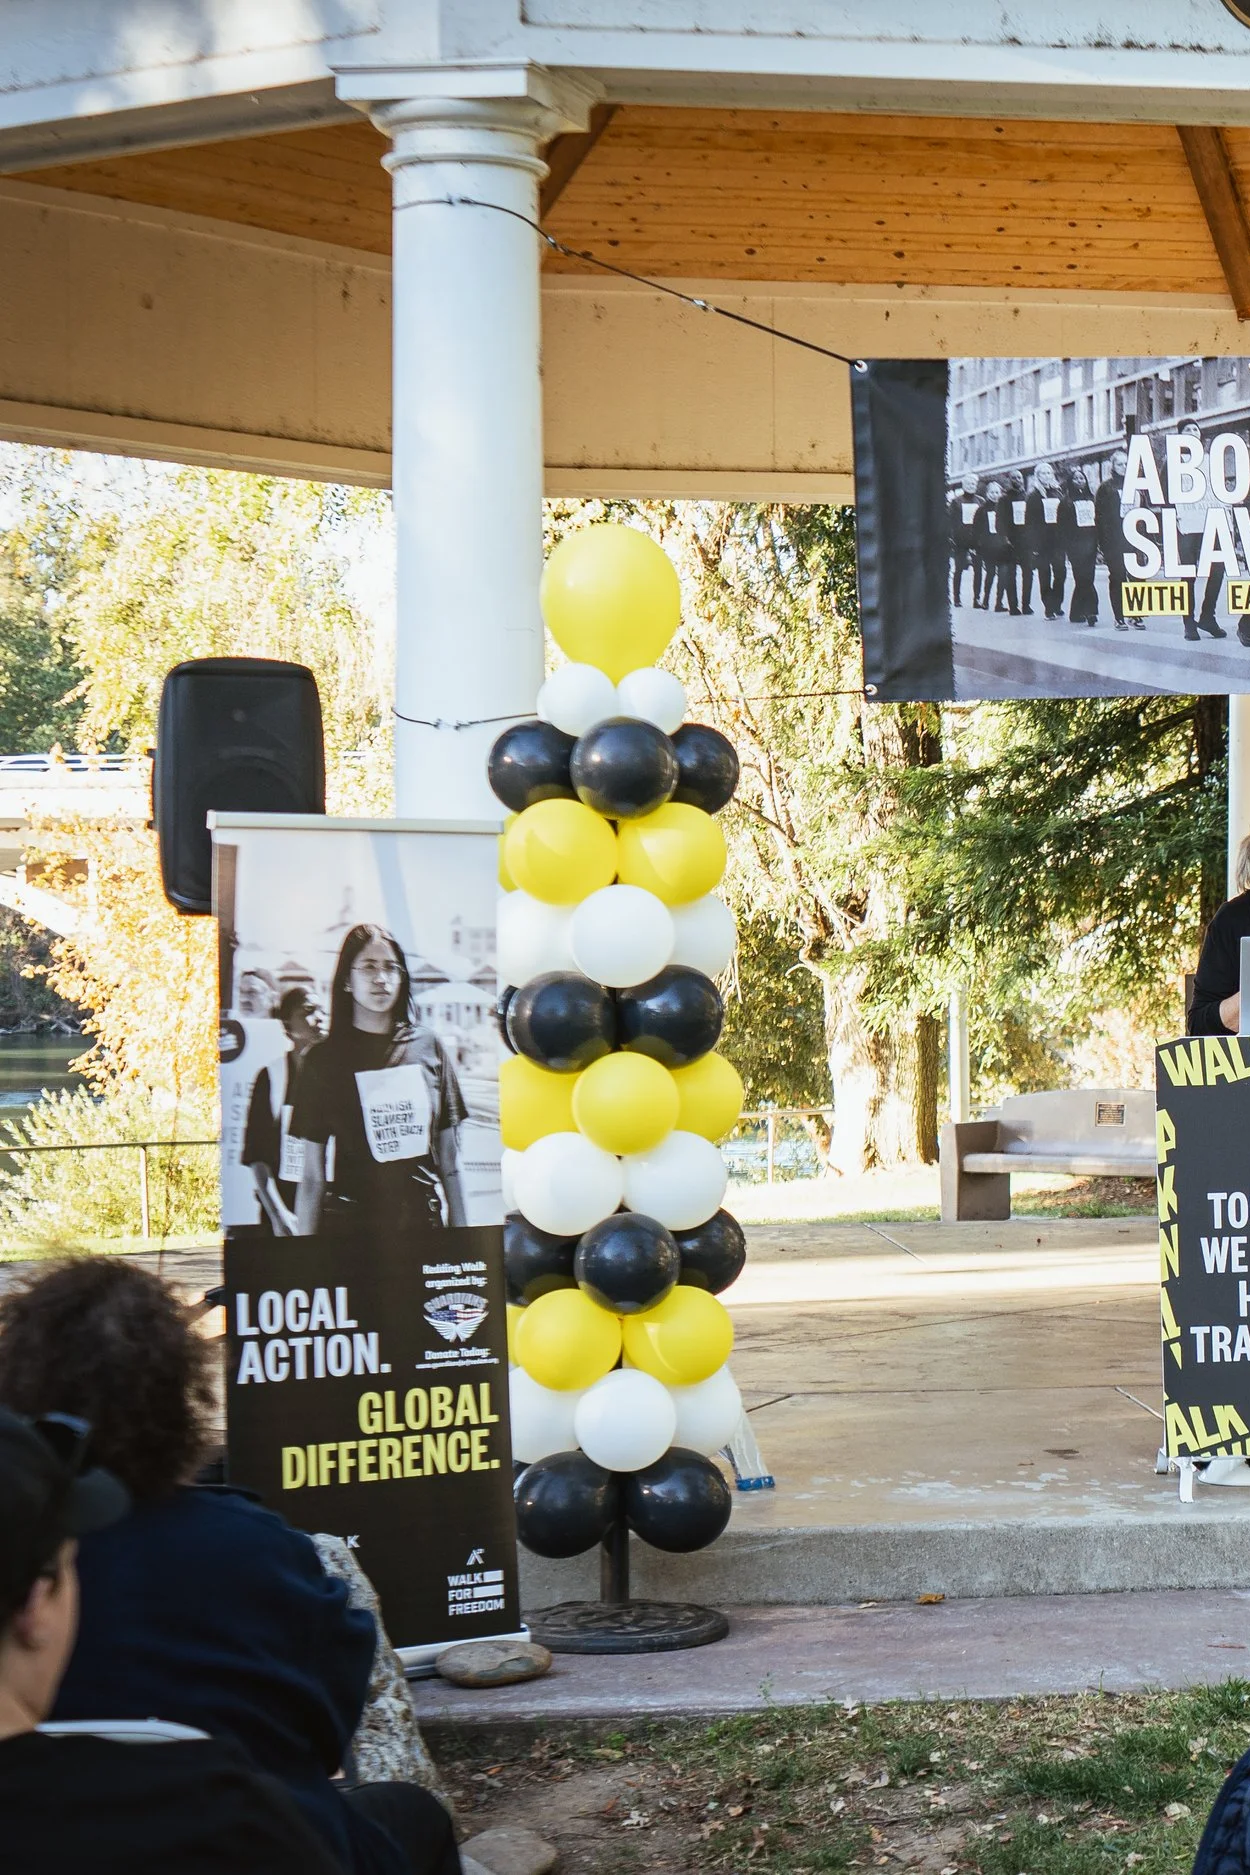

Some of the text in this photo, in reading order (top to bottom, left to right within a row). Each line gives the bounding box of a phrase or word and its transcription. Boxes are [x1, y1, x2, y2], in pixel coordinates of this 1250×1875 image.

[1125, 586, 1186, 612] WITH
[373, 1127, 398, 1141] WITH
[376, 1140, 399, 1153] STEP
[1200, 1236, 1249, 1274] WE
[236, 1286, 358, 1336] LOCAL
[236, 1331, 392, 1384] ACTION.
[358, 1382, 500, 1434] GLOBAL
[281, 1428, 500, 1490] DIFFERENCE.
[447, 1572, 483, 1587] WALK
[448, 1588, 472, 1601] FOR
[448, 1599, 505, 1616] FREEDOM
